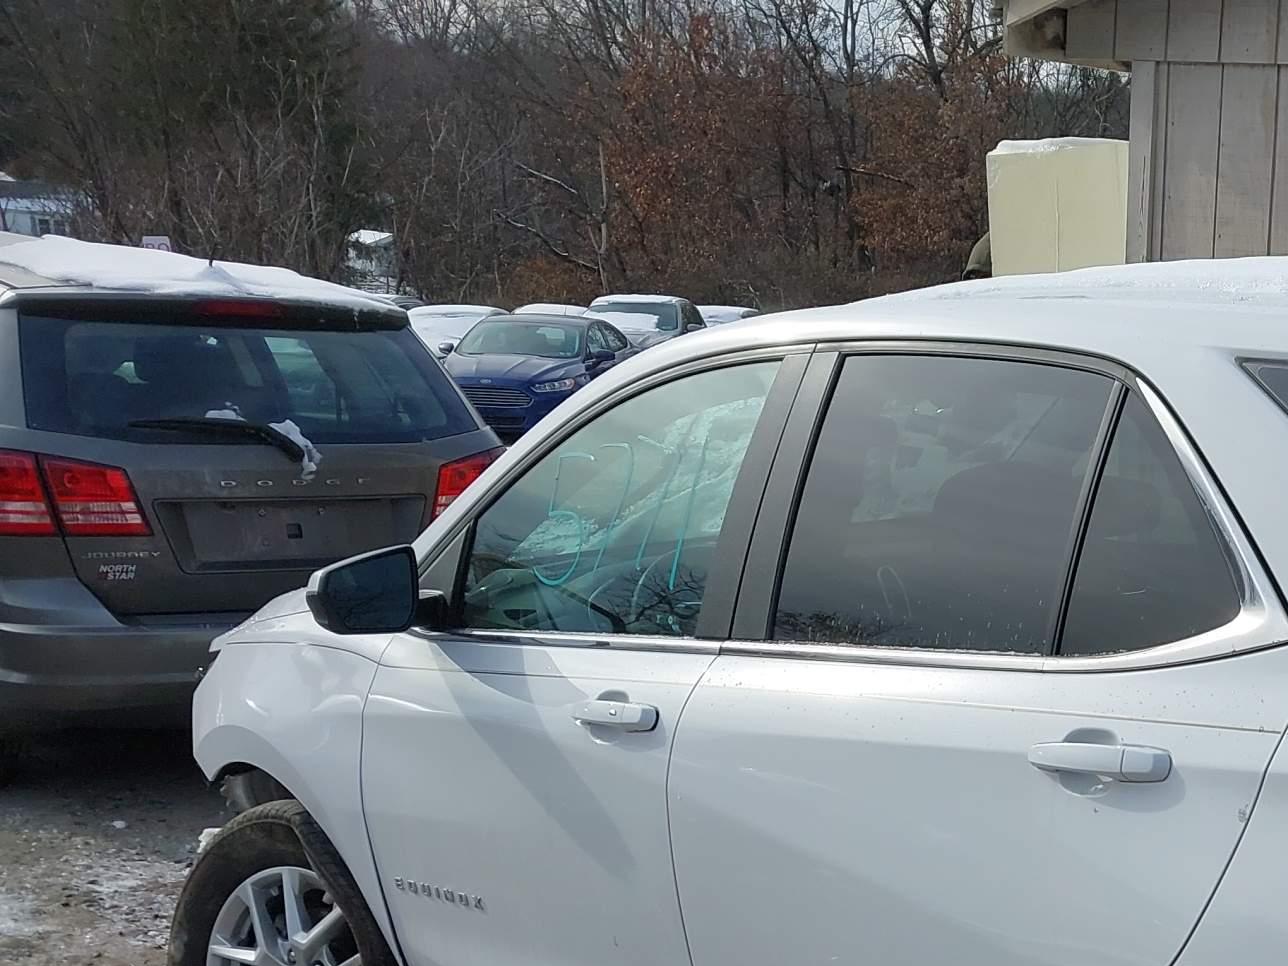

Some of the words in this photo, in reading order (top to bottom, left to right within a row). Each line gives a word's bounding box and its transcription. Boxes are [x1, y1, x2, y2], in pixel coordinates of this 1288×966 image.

[81, 551, 160, 559] JOURNEY
[99, 564, 136, 573] NORTH
[107, 572, 135, 580] STAR
[394, 876, 485, 911] EQUINOX
